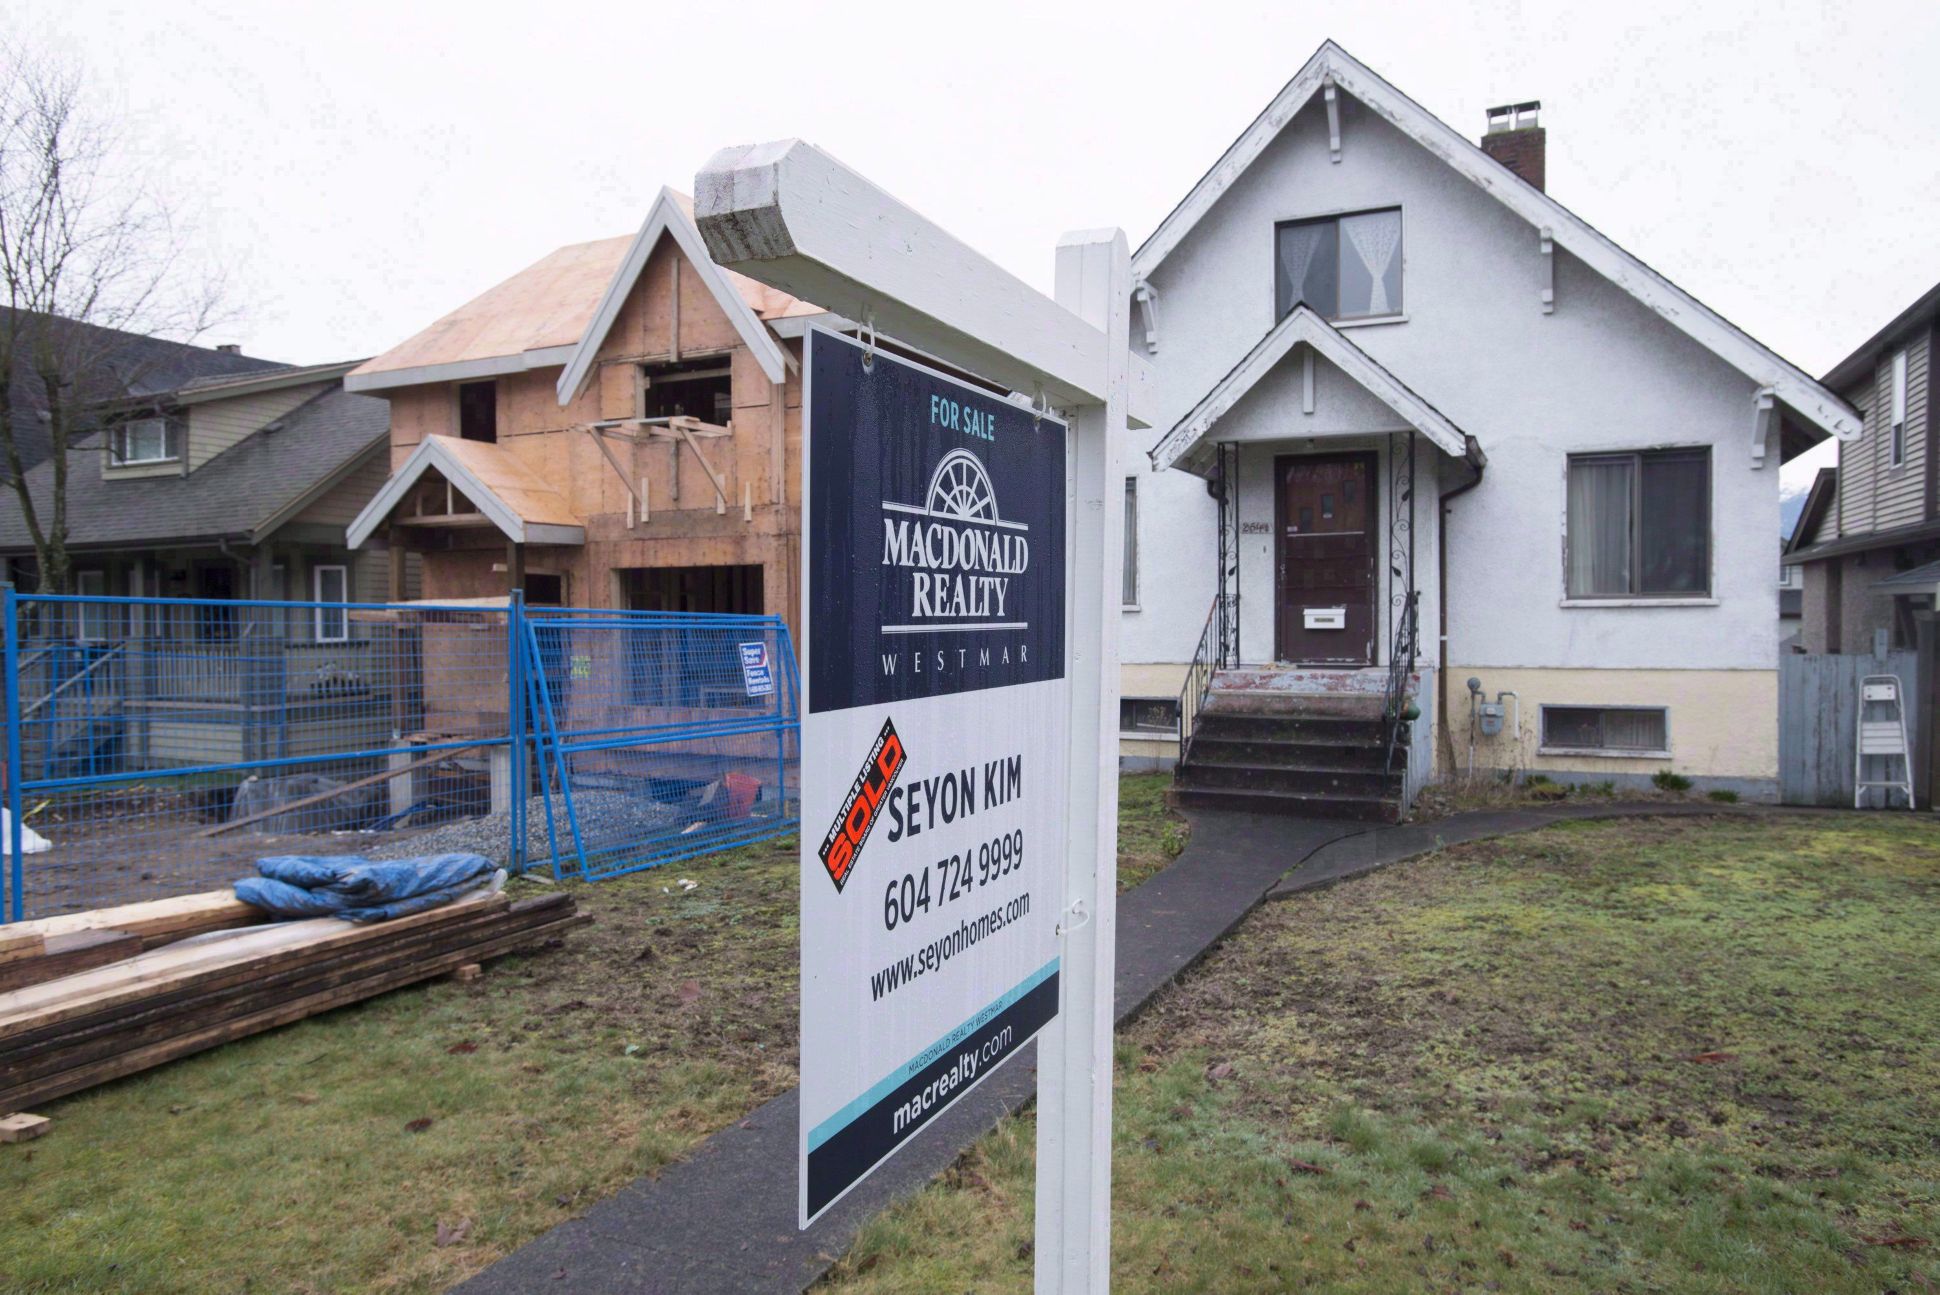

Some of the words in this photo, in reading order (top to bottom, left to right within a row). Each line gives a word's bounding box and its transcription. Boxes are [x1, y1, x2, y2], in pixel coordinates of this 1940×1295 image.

[930, 394, 959, 431] FOR
[963, 406, 995, 441] SALE
[881, 518, 1029, 574] MACDONALD
[911, 572, 1009, 617] REALTY
[882, 645, 1027, 675] WESTMAR
[828, 781, 861, 843] MULTIPLE
[859, 736, 885, 784] LISTING
[828, 734, 903, 880] SOLD
[887, 766, 975, 843] SEYON
[984, 754, 1022, 810] KIM
[884, 867, 930, 931] 604
[937, 848, 973, 906] 724
[979, 828, 1023, 887] 9999
[871, 891, 1030, 1001] www.seyonhomes.com
[893, 1025, 1012, 1135] macrealty.com
[908, 1038, 952, 1075] MACDONALD
[951, 1022, 975, 1043] REALTY
[975, 1000, 1003, 1025] WESTMAR
